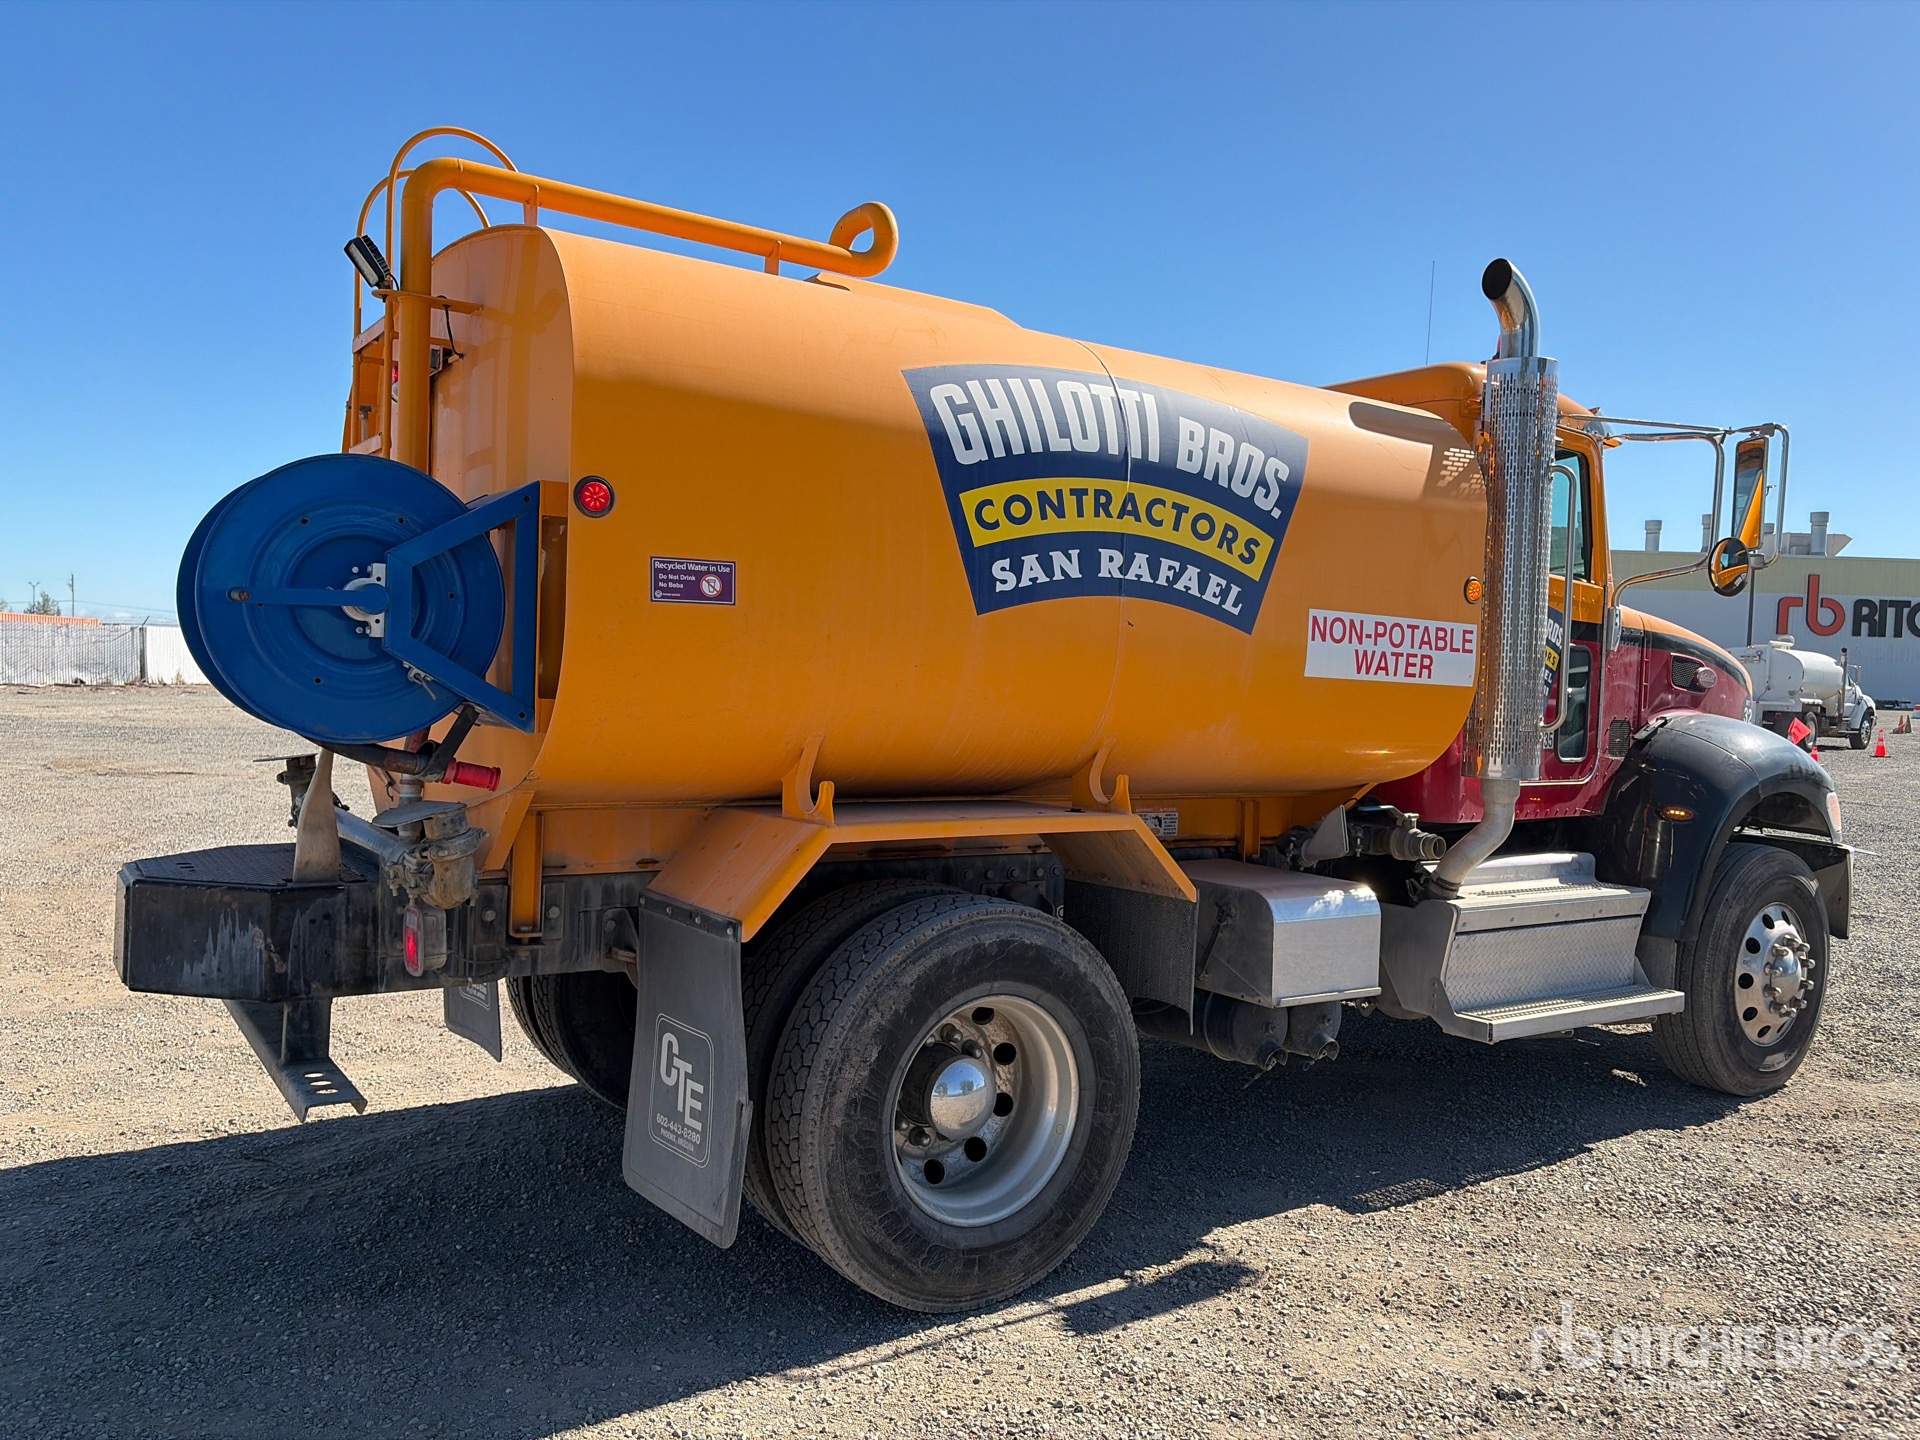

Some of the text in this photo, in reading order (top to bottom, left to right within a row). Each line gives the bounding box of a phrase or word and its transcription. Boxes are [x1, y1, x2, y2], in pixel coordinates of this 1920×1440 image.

[930, 378, 1290, 519] GHILOTTI BROS.
[974, 487, 1262, 565] CONTRACTORS
[654, 561, 731, 573] Recycled Water in Use
[991, 548, 1243, 616] SAN RAFAEL
[1310, 615, 1474, 655] NON-POTABLE
[1776, 574, 1846, 636] rb
[1354, 648, 1434, 680] WATER
